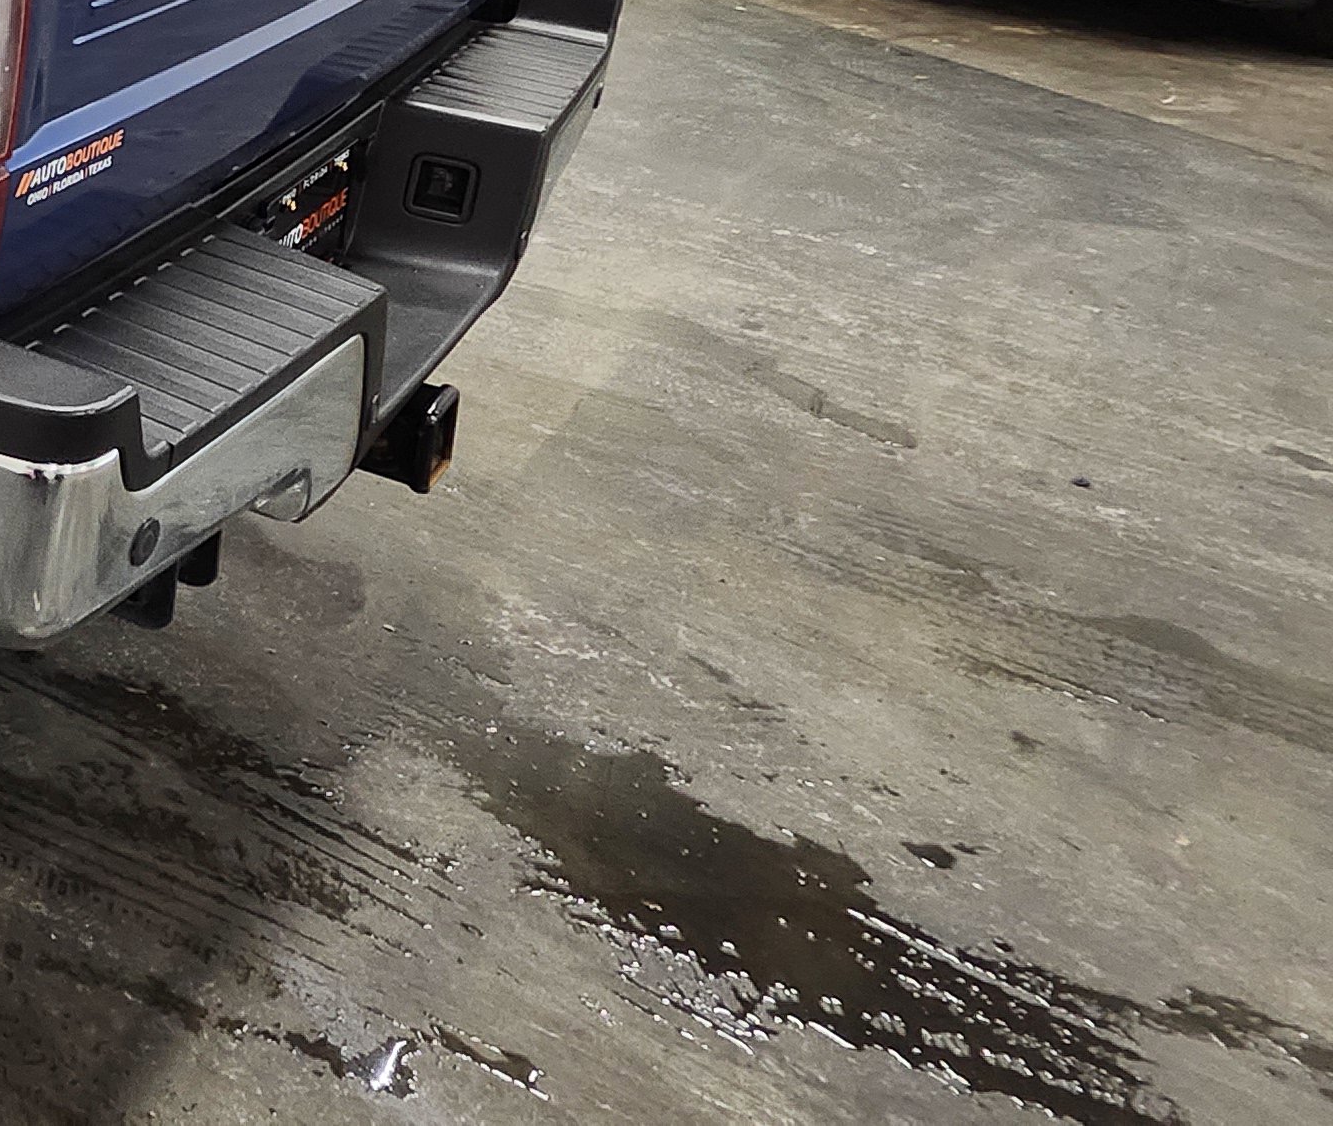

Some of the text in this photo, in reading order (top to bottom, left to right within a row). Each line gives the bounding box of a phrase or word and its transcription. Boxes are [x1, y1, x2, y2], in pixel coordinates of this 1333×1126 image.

[26, 155, 113, 206] OHIO FLORIDA TEXAS
[30, 128, 125, 189] AUTOBOUTIQUE
[278, 186, 350, 249] UTOBOUTIQUE
